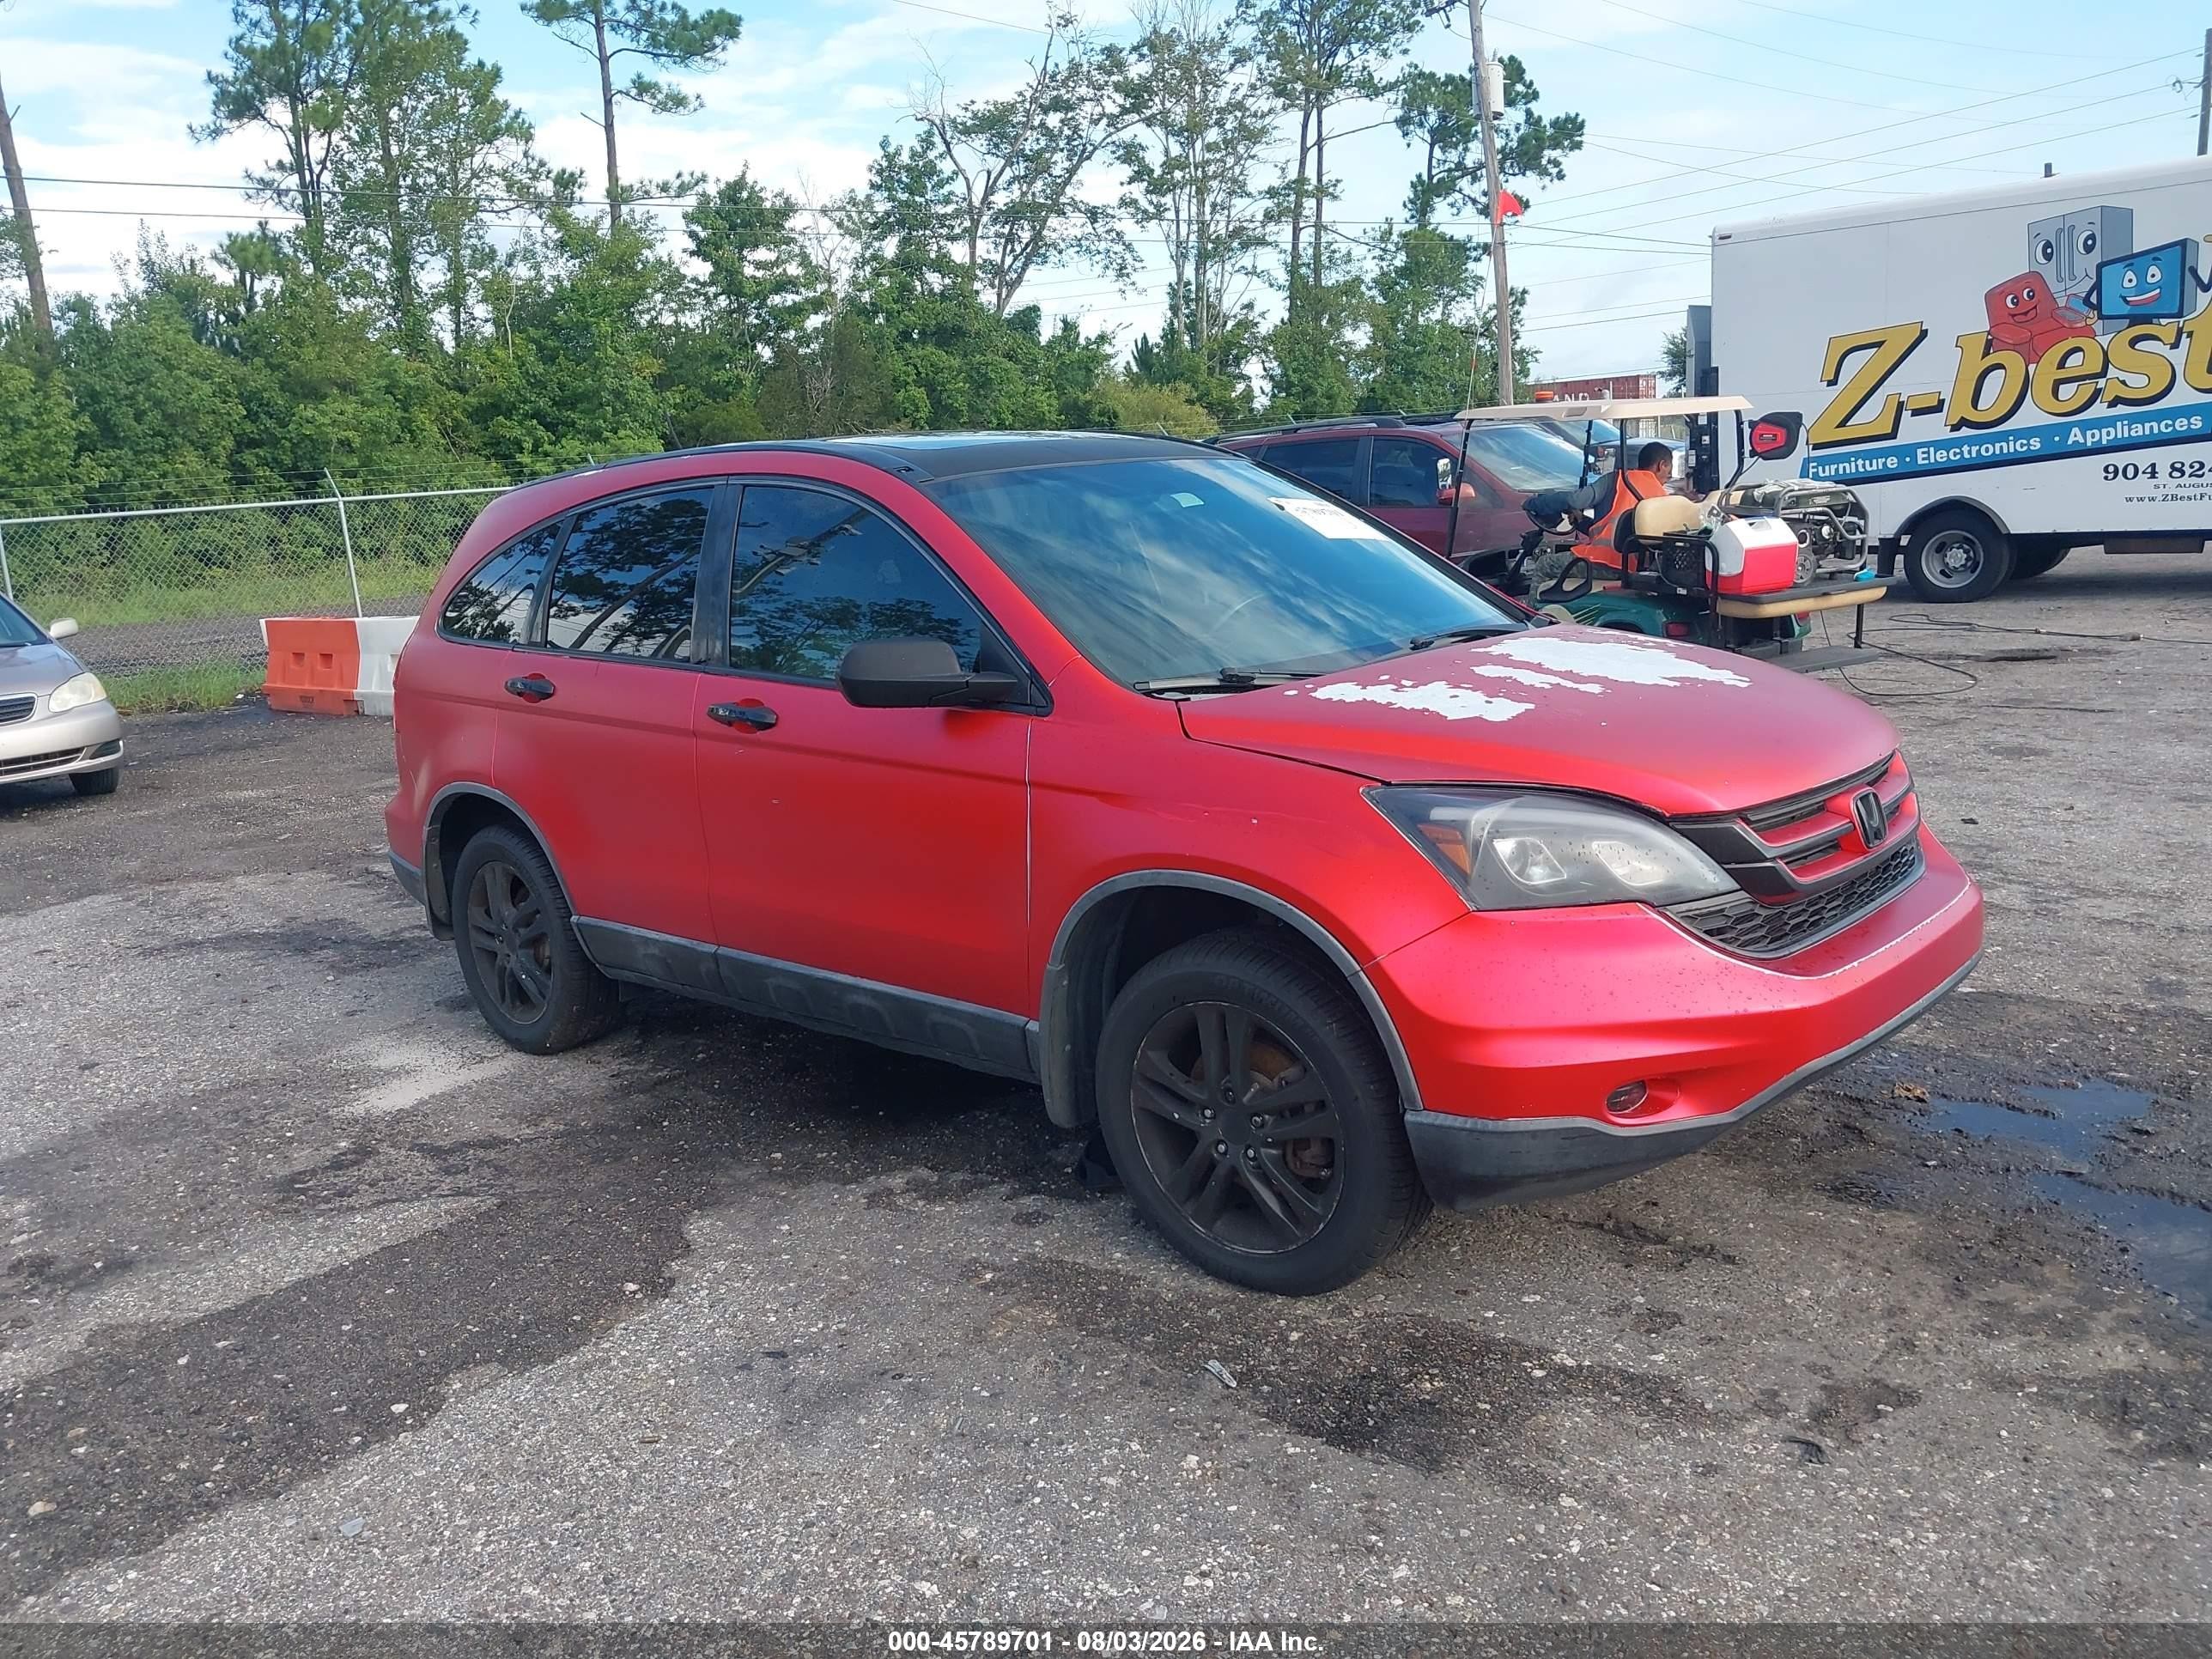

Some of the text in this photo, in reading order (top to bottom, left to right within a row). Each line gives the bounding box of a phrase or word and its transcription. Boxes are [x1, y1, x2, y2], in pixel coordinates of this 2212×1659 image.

[1808, 415, 2203, 478] Furniture Electronics Appliances
[2102, 460, 2212, 481] 904 82
